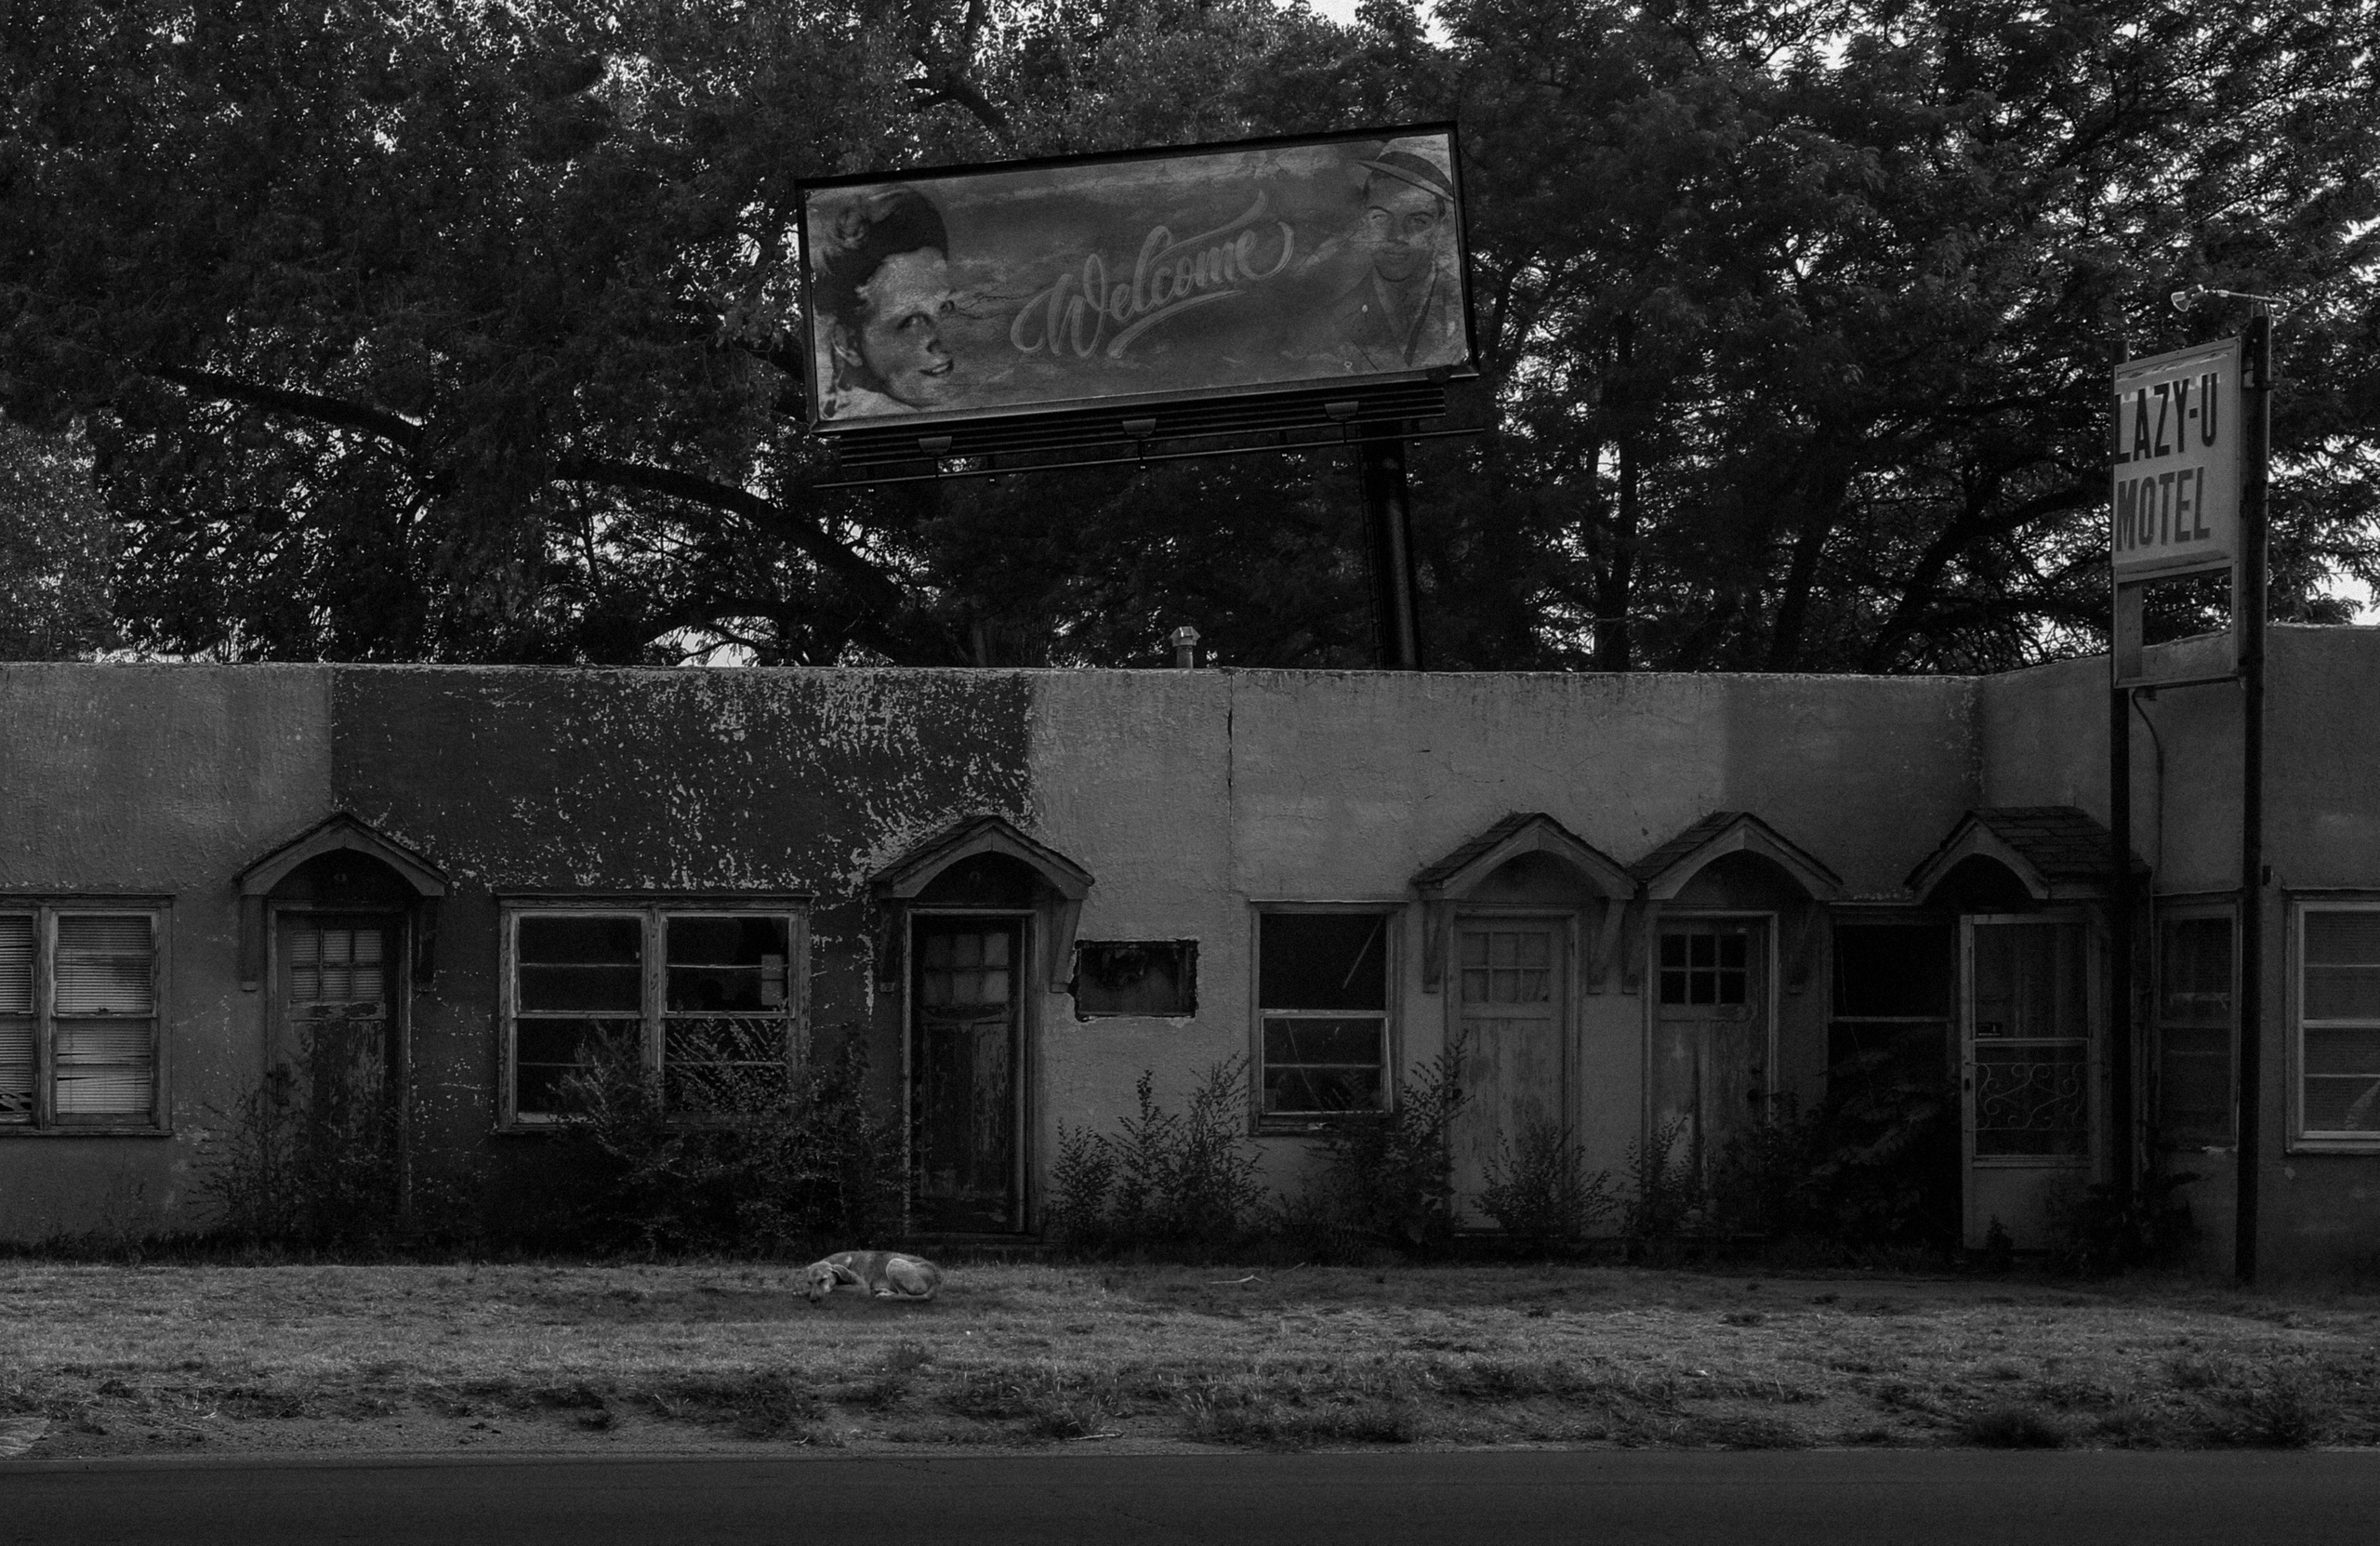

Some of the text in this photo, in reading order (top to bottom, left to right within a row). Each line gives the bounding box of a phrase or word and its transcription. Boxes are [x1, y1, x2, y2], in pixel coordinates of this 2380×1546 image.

[1011, 191, 1293, 359] Welcome
[2115, 373, 2216, 464] LAZY-U
[2118, 468, 2210, 551] MOTEL
